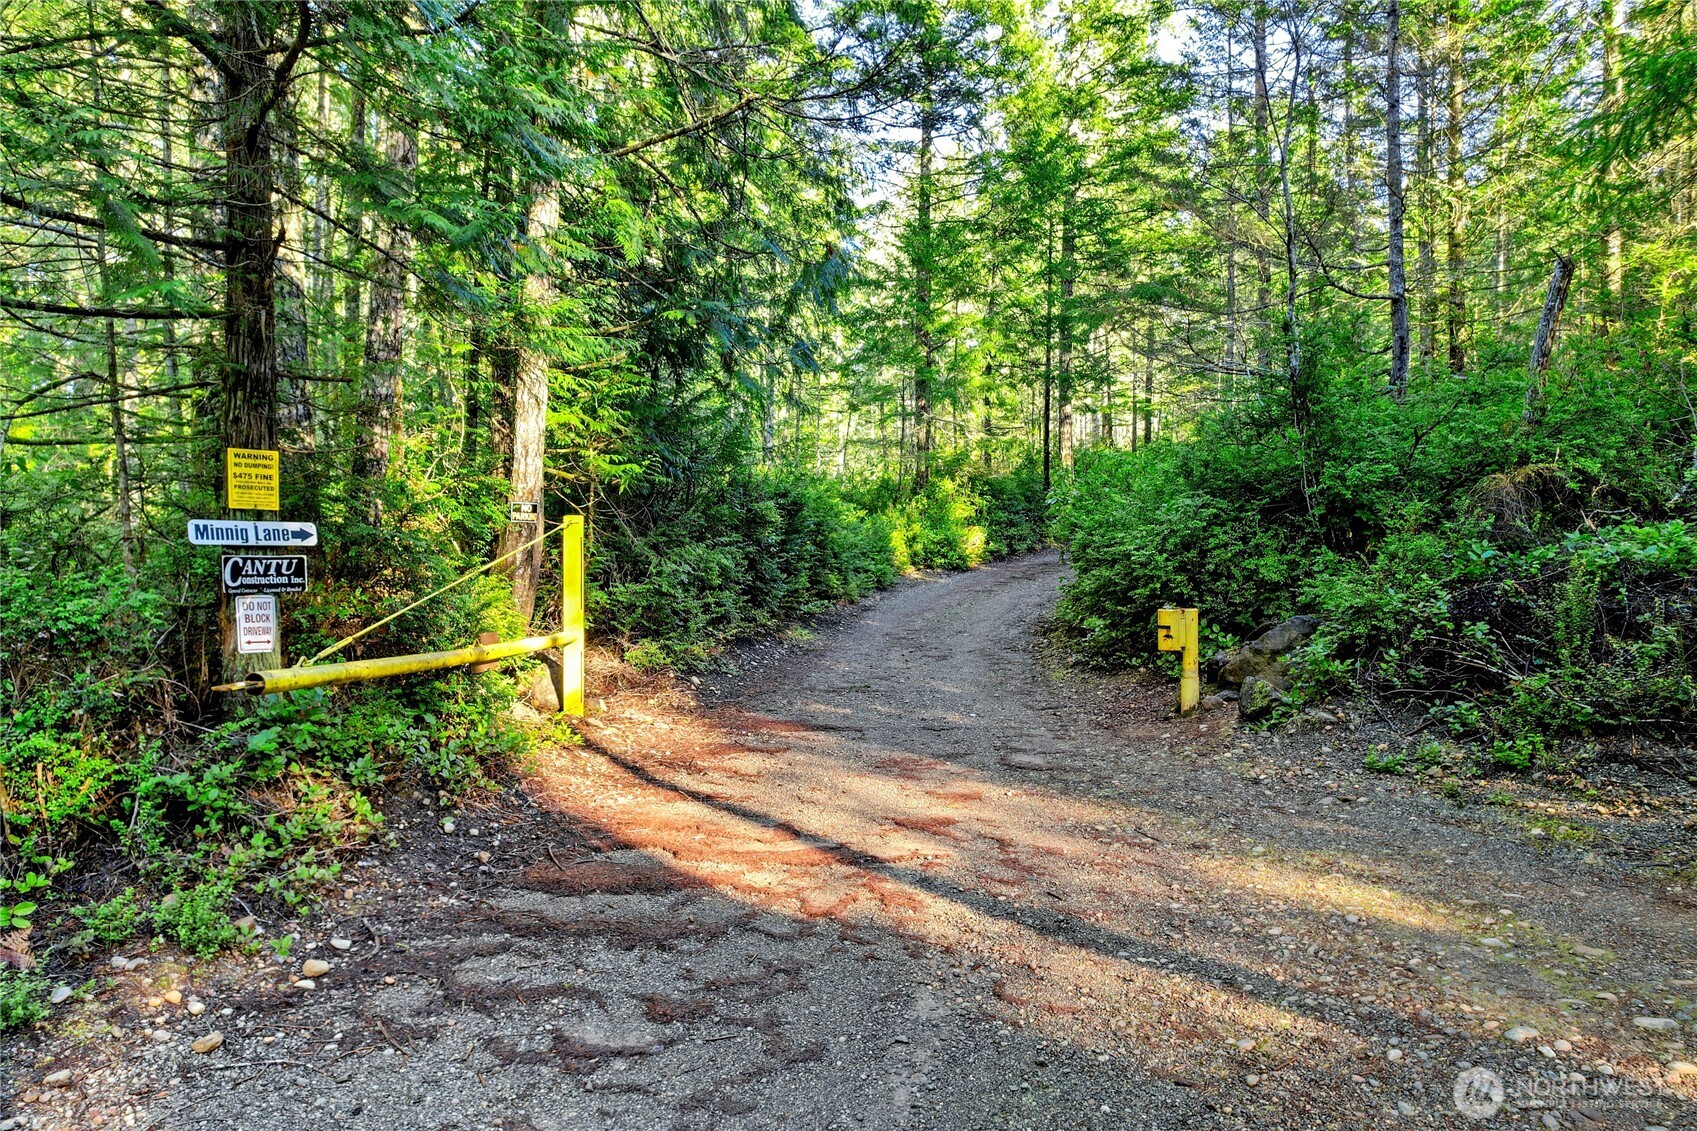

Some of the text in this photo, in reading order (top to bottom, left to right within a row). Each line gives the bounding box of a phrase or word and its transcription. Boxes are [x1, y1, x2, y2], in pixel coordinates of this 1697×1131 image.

[233, 452, 274, 462] WARNING
[232, 472, 274, 481] $475 FINE
[233, 484, 275, 492] PROSECUTED
[521, 504, 532, 513] NO
[194, 523, 290, 543] Minnig Lane
[225, 557, 298, 587] CANTU
[290, 575, 306, 584] Inc.
[242, 601, 272, 611] DO NOT
[245, 614, 271, 623] BLOCK
[243, 627, 272, 636] DRIVEWAY
